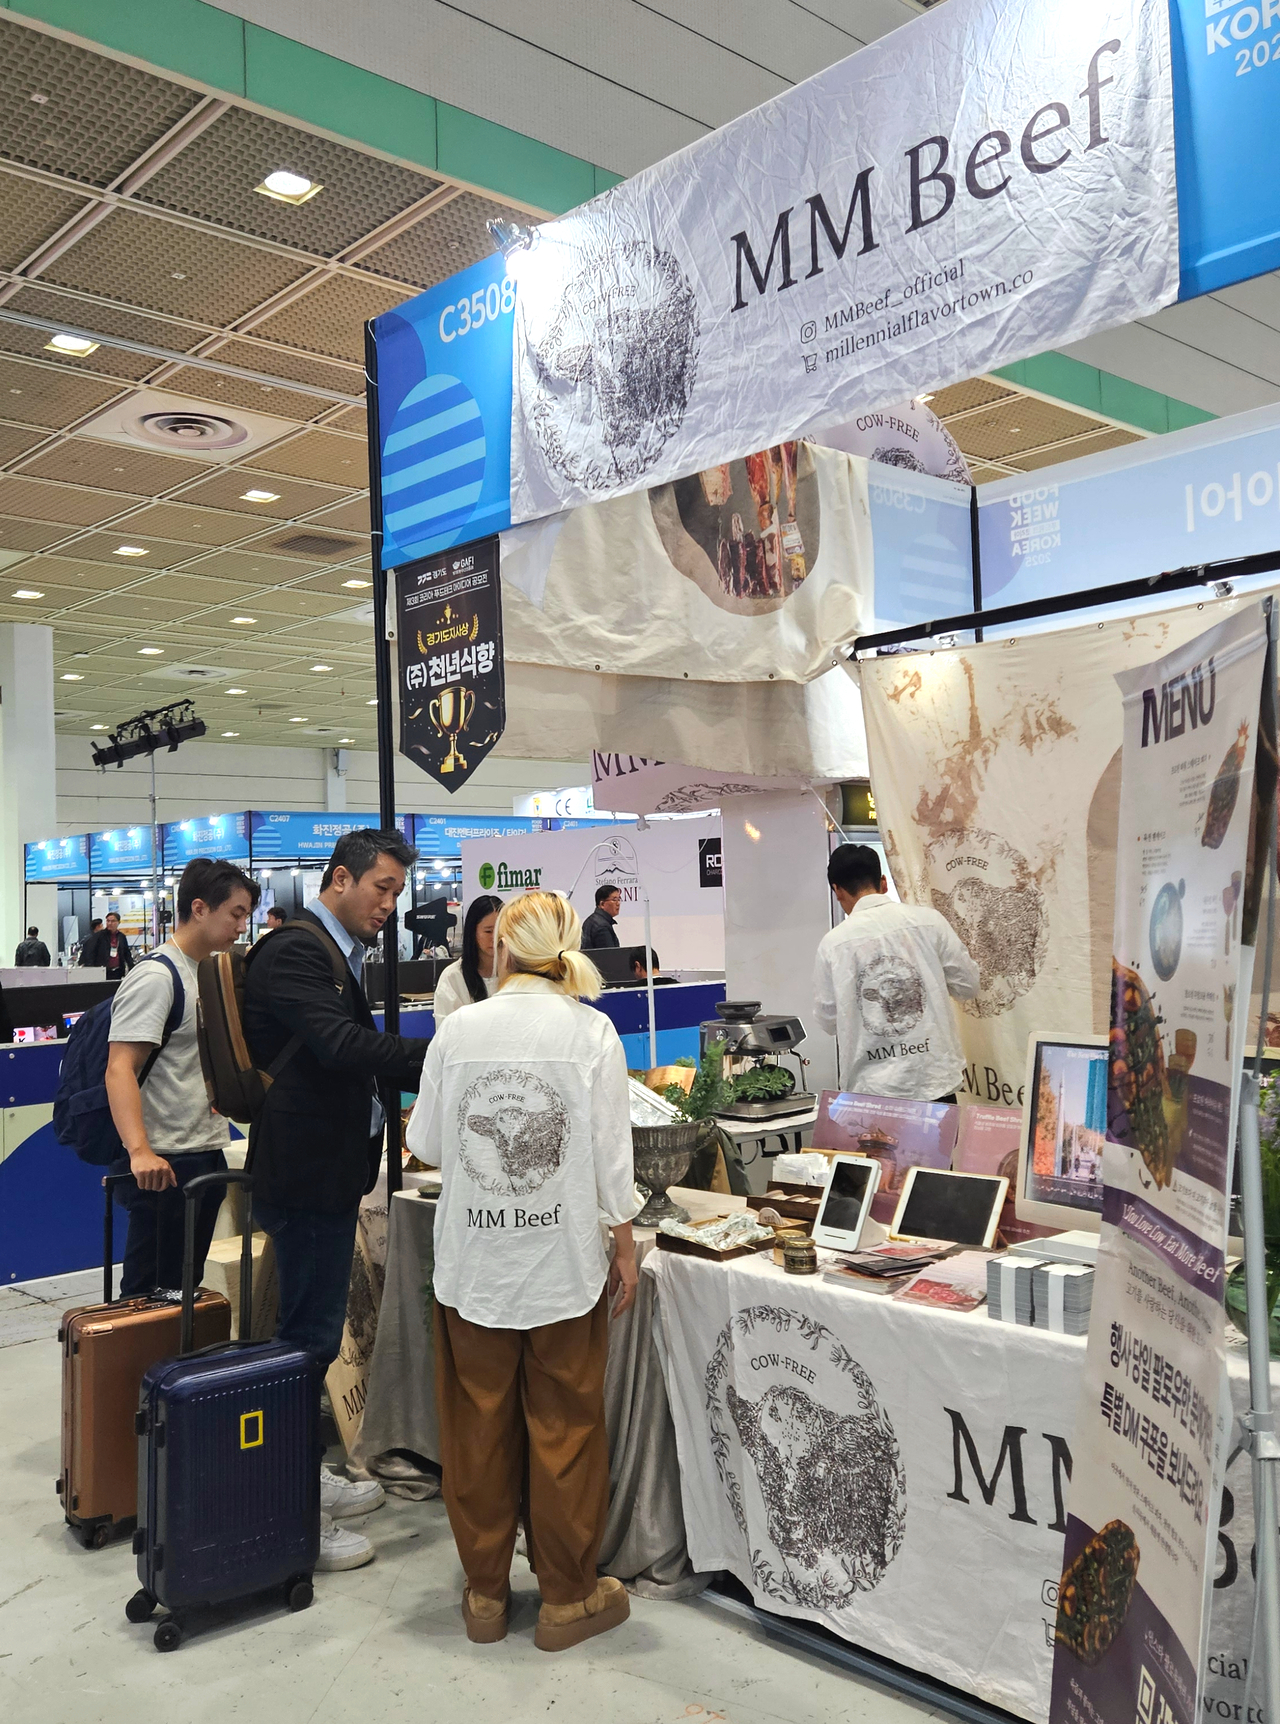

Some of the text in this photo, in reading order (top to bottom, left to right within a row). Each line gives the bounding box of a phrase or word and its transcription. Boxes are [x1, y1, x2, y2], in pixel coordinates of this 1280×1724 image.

[730, 38, 1121, 313] MM Beef
[439, 275, 515, 343] C3508
[824, 259, 966, 334] MMBeef_official
[825, 269, 1035, 364] millennialflavortown.co
[856, 414, 920, 442] COW-FREE
[460, 555, 475, 569] GAFI
[426, 622, 469, 646] 경기도지사상
[1141, 655, 1216, 749] MENU
[269, 815, 291, 823] C2407
[429, 817, 447, 825] C2401
[497, 862, 542, 888] fimar
[945, 856, 989, 873] COW-FREE
[595, 876, 638, 886] Stefano Ferrara
[866, 1038, 930, 1061] MM Beef
[488, 1093, 526, 1105] COW-FREE
[467, 1203, 562, 1229] MM Beef
[1134, 1214, 1153, 1235] Love
[1163, 1235, 1180, 1255] Eat
[1174, 1243, 1197, 1268] More
[1193, 1252, 1223, 1284] Beef
[750, 1353, 817, 1385] COW-FREE
[1110, 1320, 1132, 1377] 행사
[1132, 1337, 1153, 1394] 당일
[1152, 1352, 1192, 1429] 팔로우한
[1100, 1381, 1125, 1436] 특별
[1122, 1400, 1141, 1449] DM
[1139, 1414, 1169, 1481] 쿠폰을
